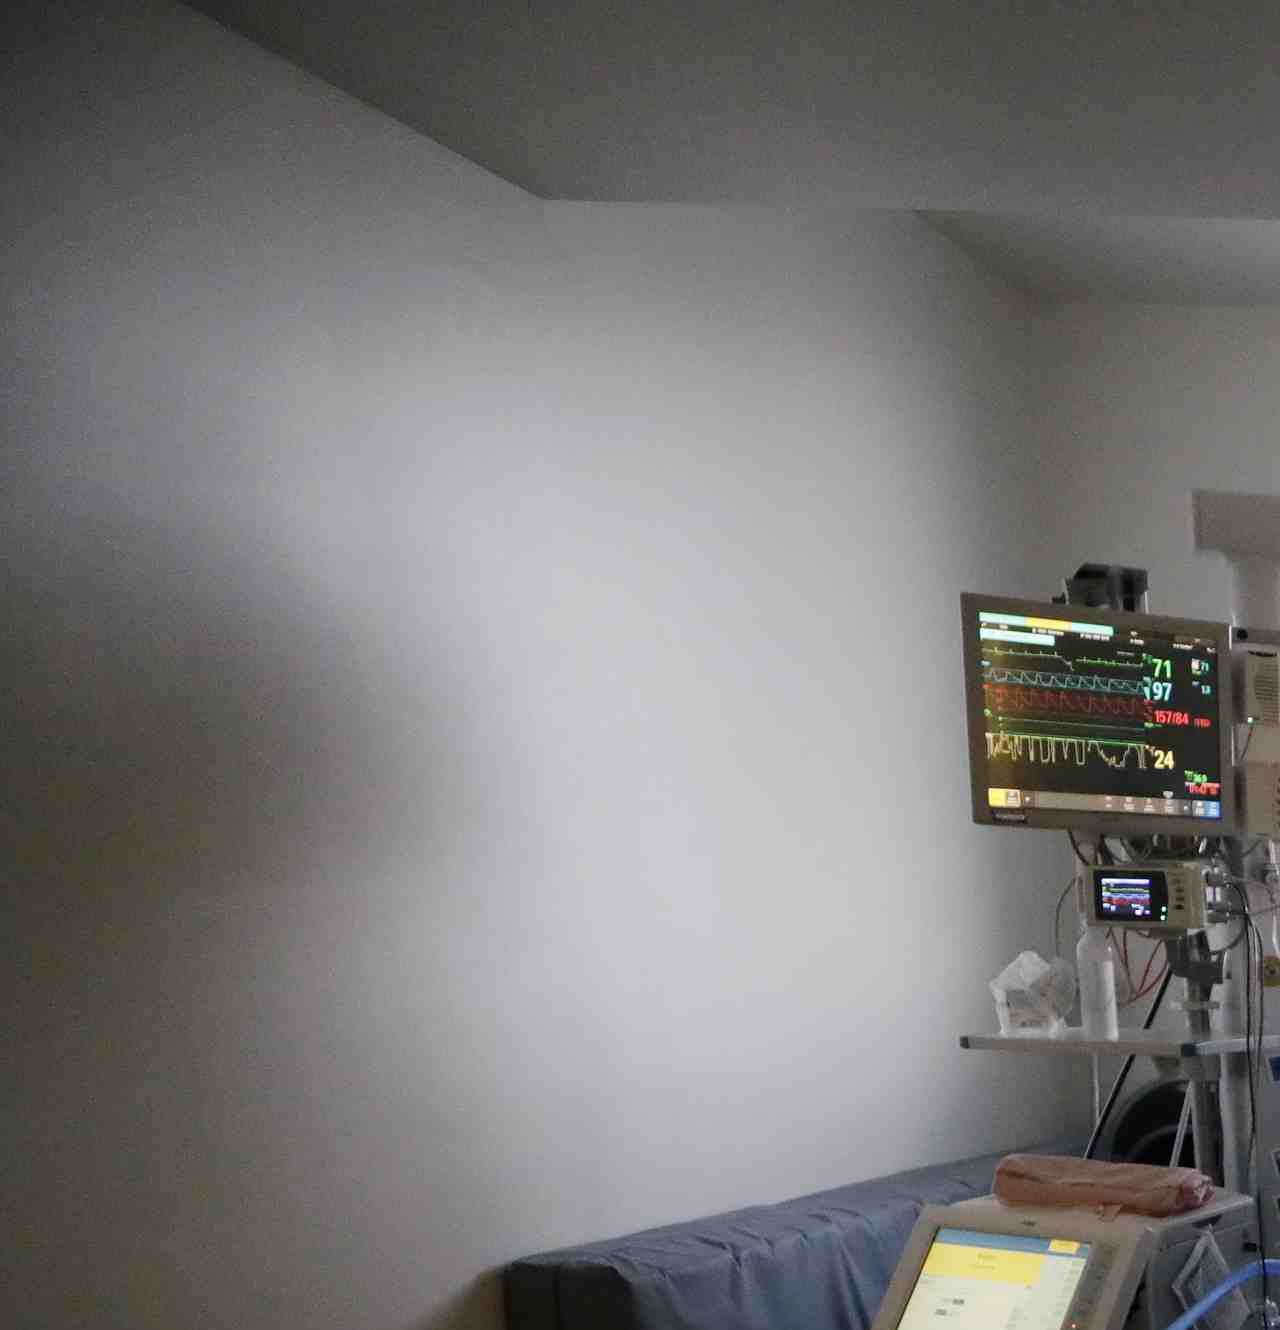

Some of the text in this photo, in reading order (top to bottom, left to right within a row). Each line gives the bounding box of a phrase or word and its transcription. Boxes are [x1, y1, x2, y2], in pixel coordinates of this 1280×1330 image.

[1151, 658, 1172, 679] 71
[1152, 681, 1173, 702] 97
[1153, 749, 1176, 770] 24
